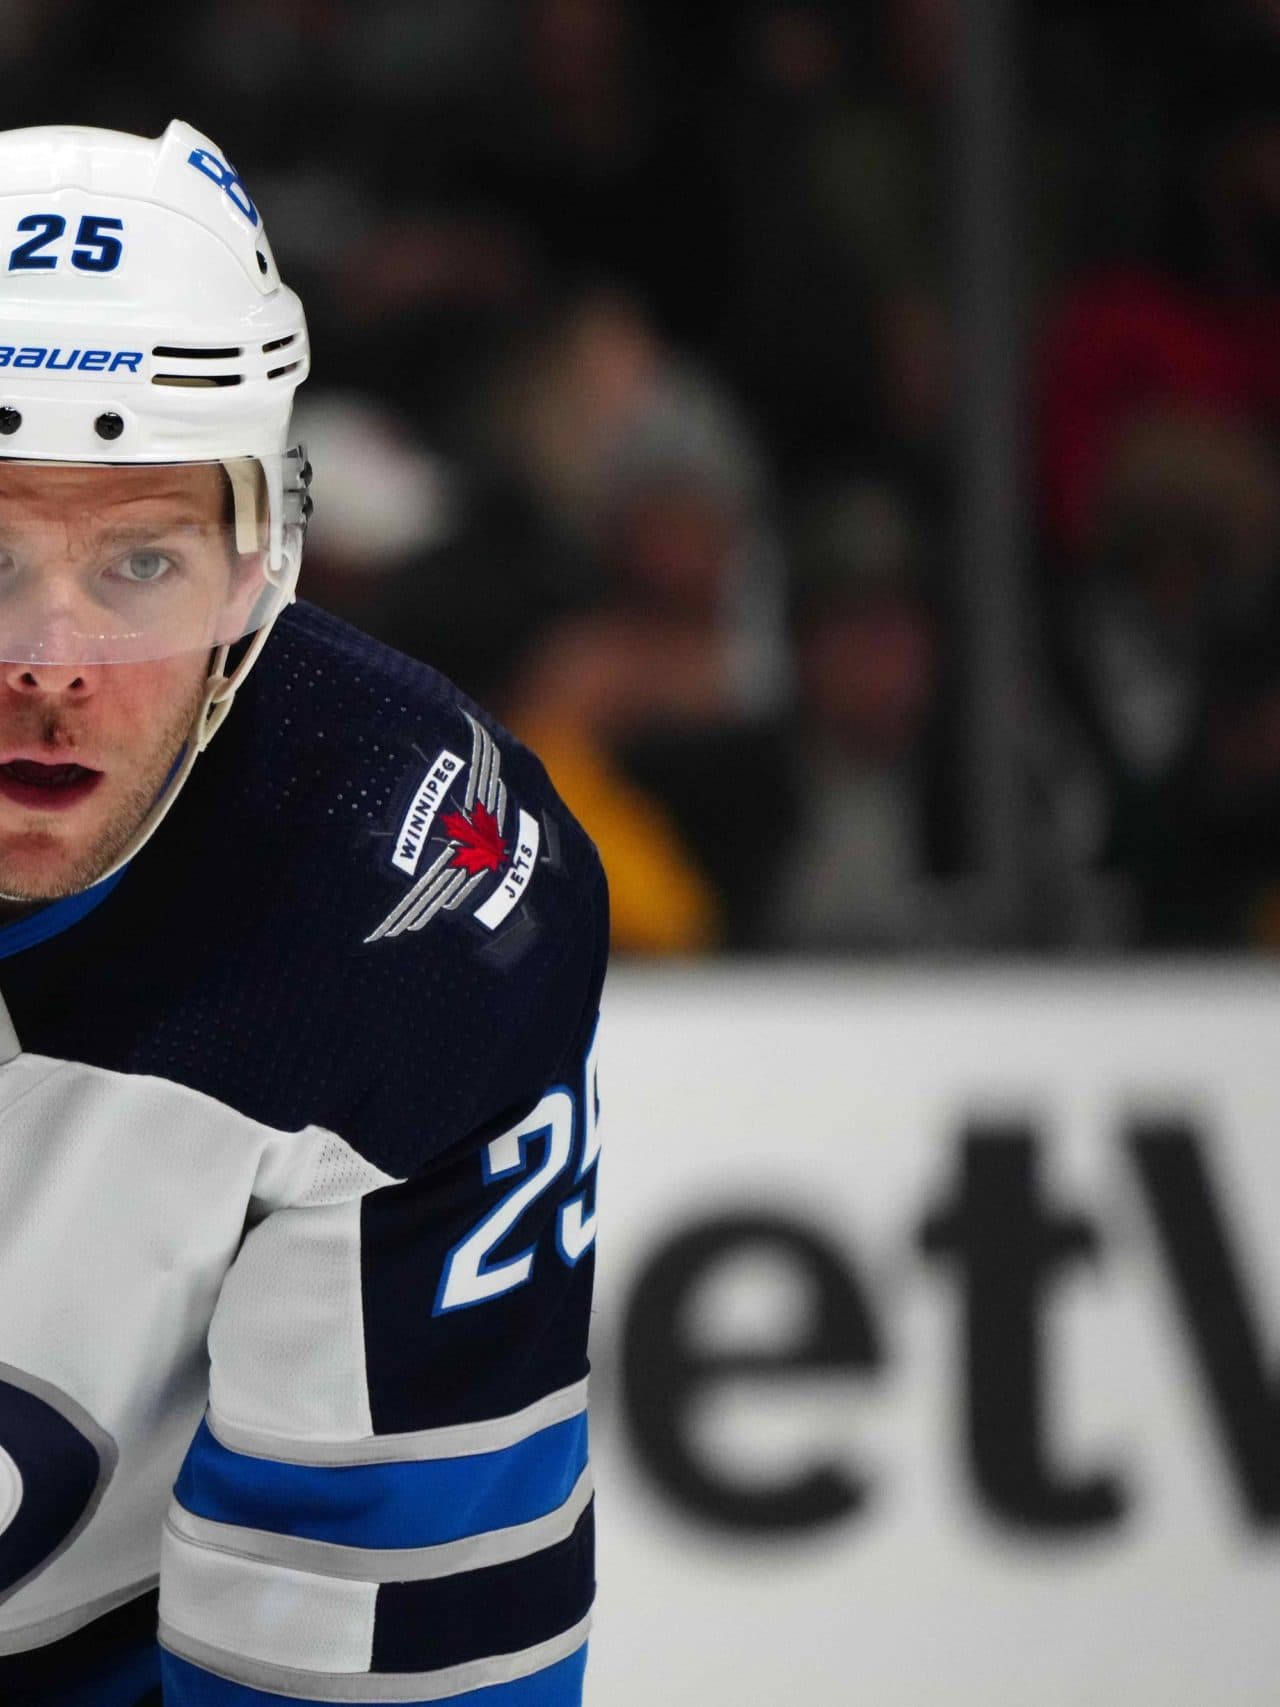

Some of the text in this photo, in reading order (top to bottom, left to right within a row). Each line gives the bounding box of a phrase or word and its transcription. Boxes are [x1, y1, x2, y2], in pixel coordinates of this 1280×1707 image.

[8, 213, 124, 273] 25
[399, 757, 457, 861] WINNIPEG
[505, 842, 533, 899] JETS
[615, 1118, 1280, 1545] et
